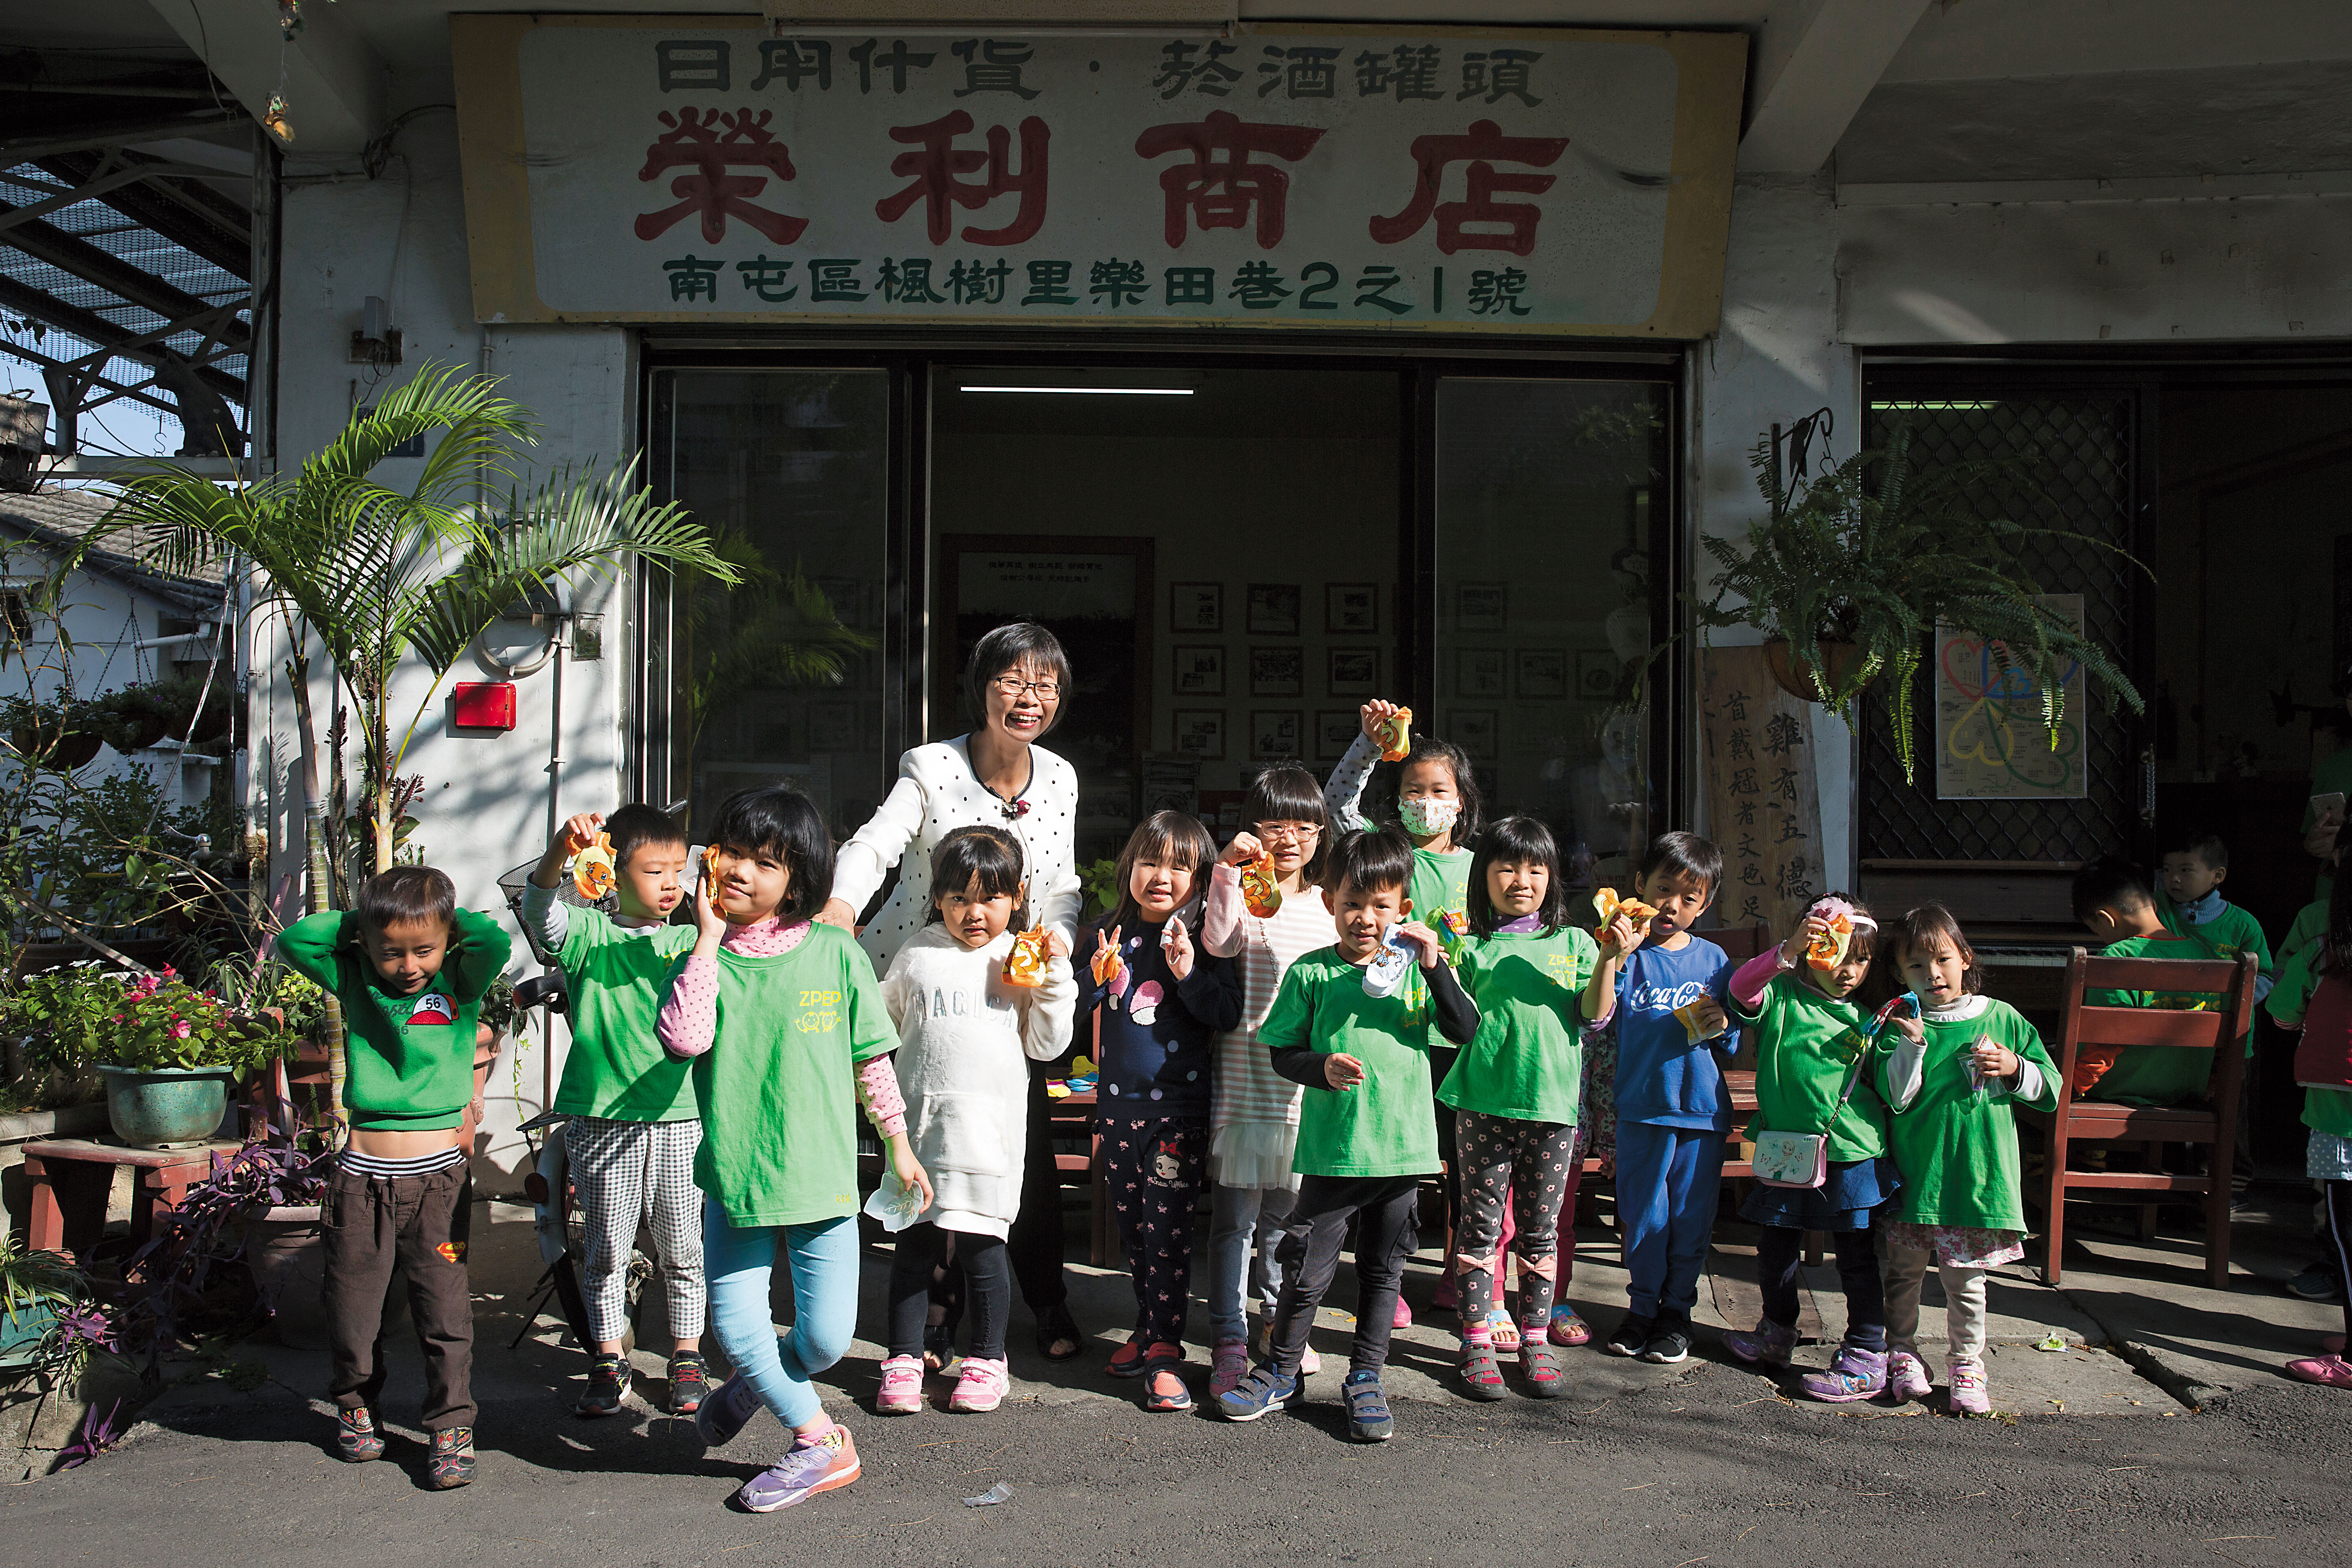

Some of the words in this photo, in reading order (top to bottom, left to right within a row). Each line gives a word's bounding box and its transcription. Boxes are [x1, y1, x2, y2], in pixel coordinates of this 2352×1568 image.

[654, 37, 1042, 100] 日用什貨
[1152, 39, 1545, 108] 菸酒罐頭
[633, 106, 1570, 256] 榮利商店
[662, 254, 1533, 316] 南屯區楓樹里樂田巷2之1號
[425, 997, 441, 1009] 56
[799, 991, 842, 1007] ZPEP
[912, 987, 1018, 1033] MAGICA
[1404, 986, 1426, 1005] ZPE
[1630, 980, 1706, 1012] Coca-Co
